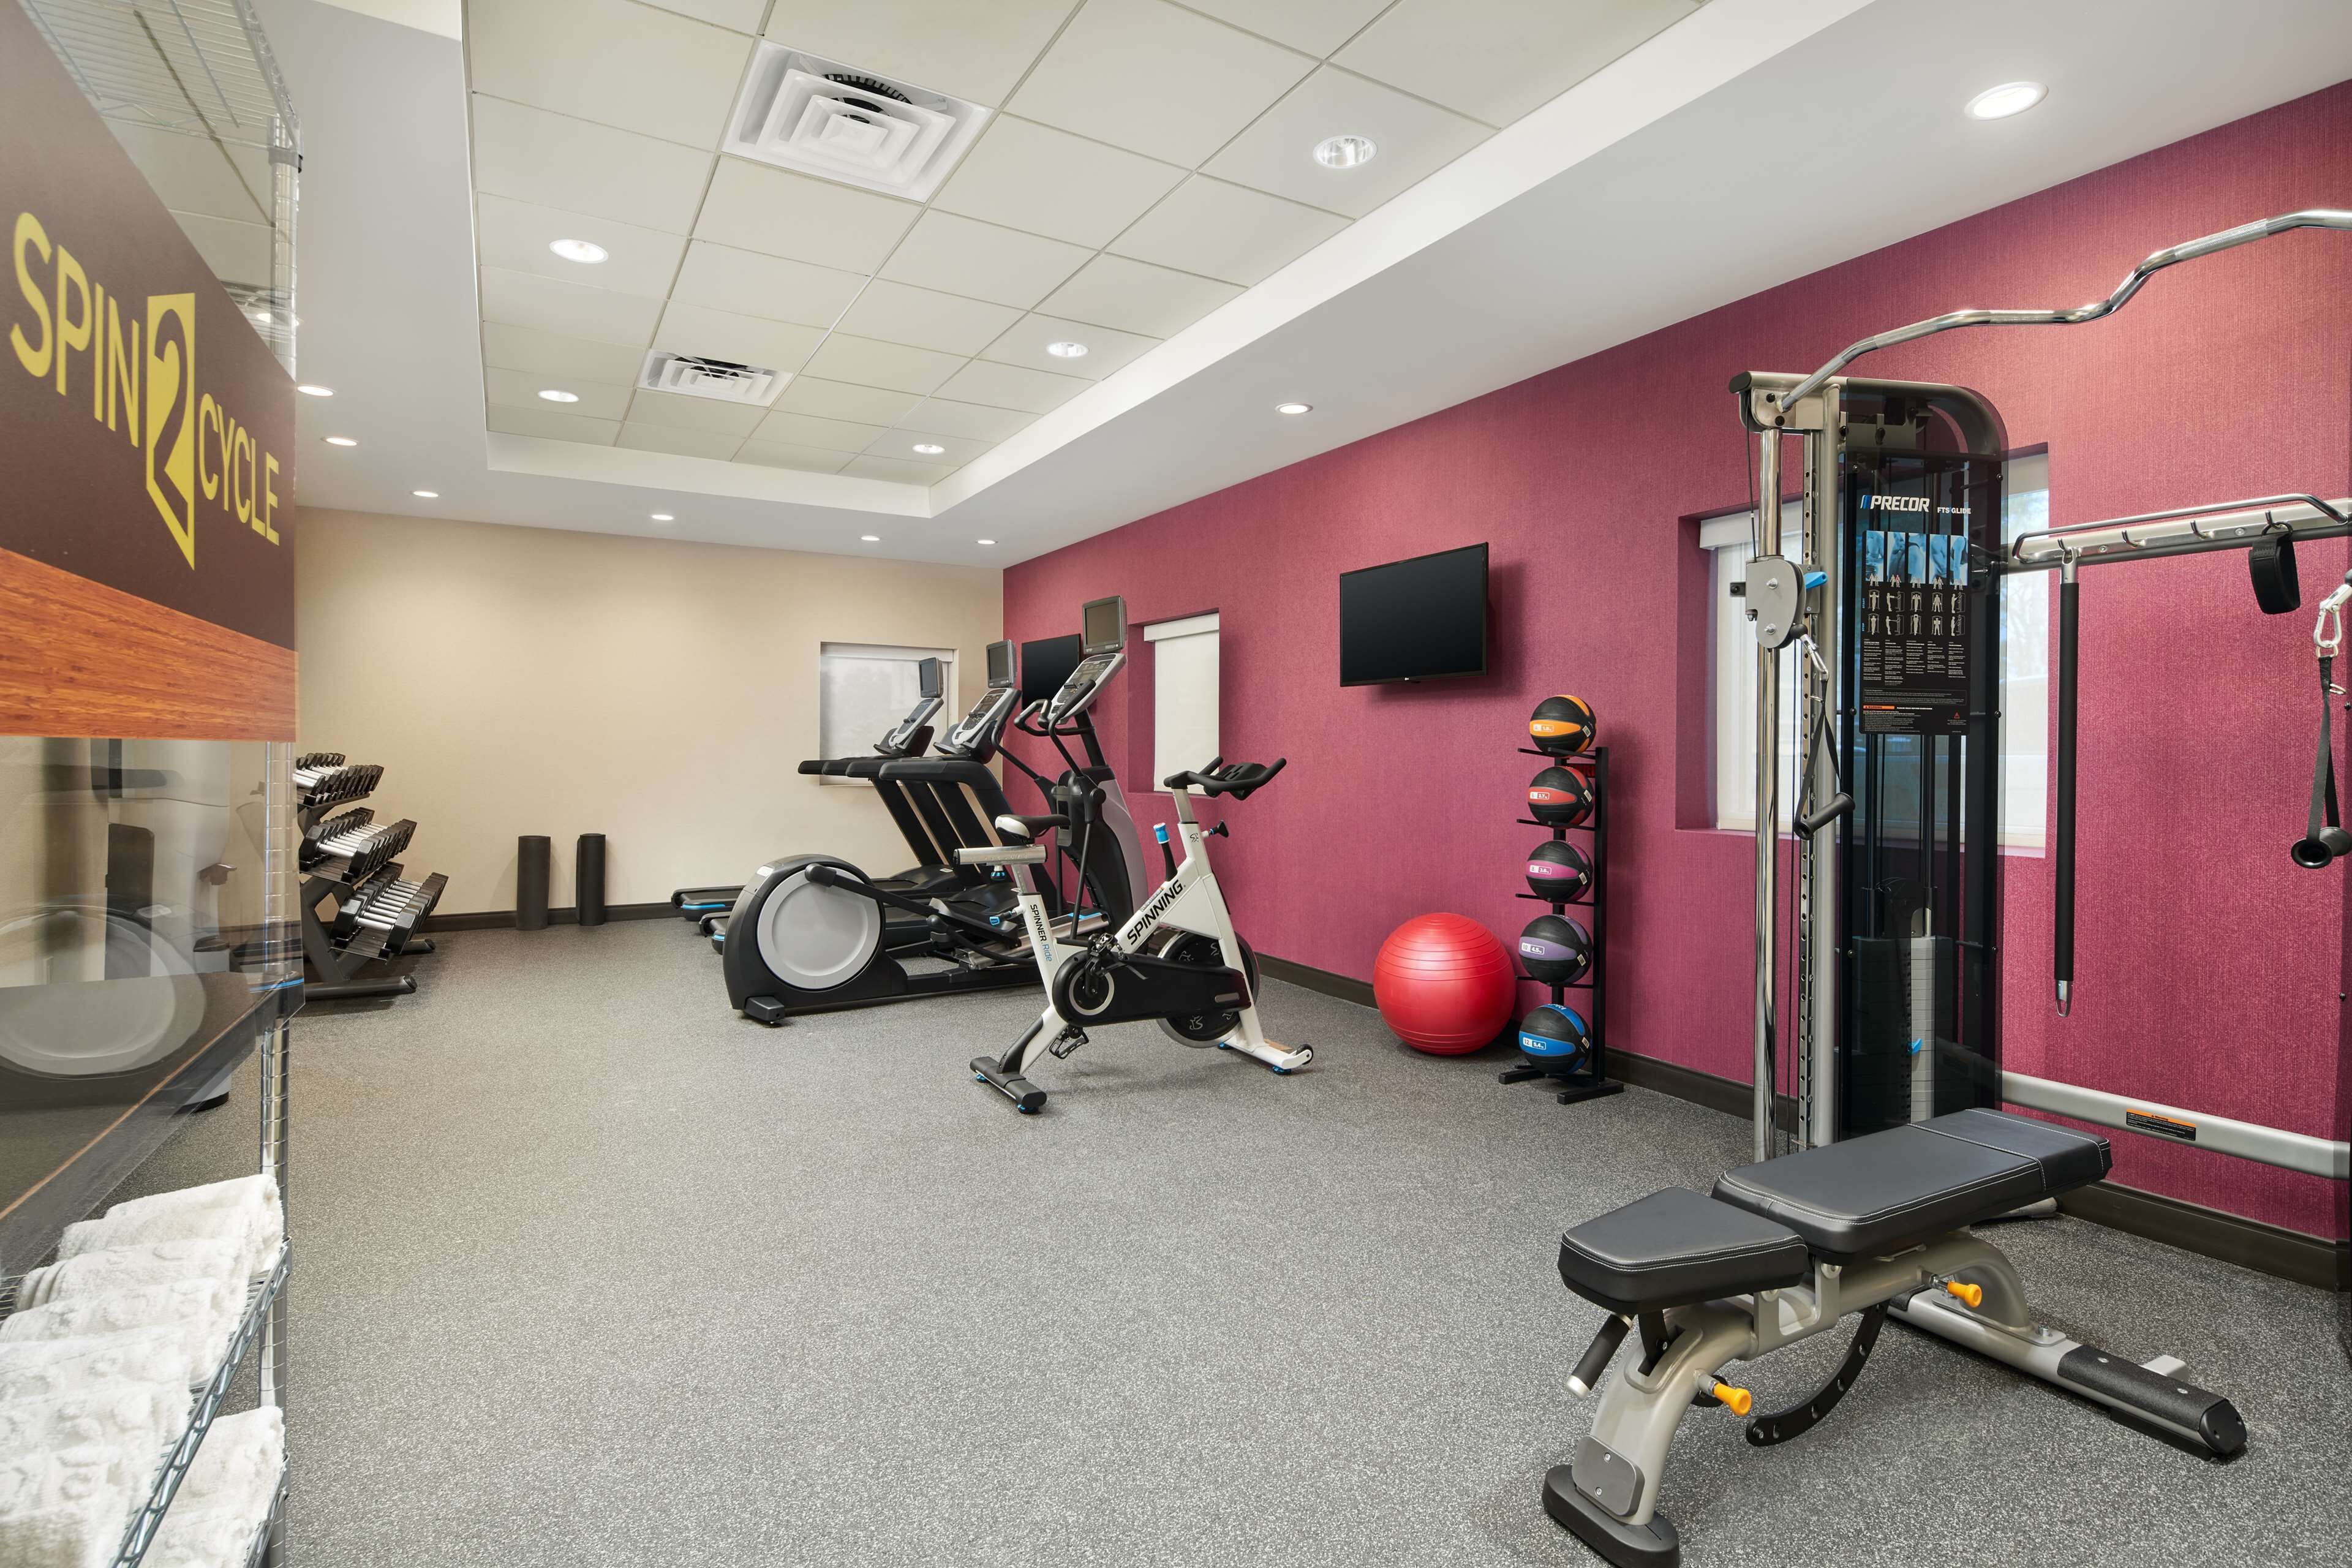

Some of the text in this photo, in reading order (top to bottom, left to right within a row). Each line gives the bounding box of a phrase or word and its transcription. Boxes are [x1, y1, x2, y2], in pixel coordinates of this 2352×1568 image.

[10, 212, 279, 546] SPIN 2 CYCLE
[1870, 495, 1929, 512] PRECOR
[1030, 904, 1052, 962] SPINNER Ride
[1127, 879, 1183, 945] SPINNING
